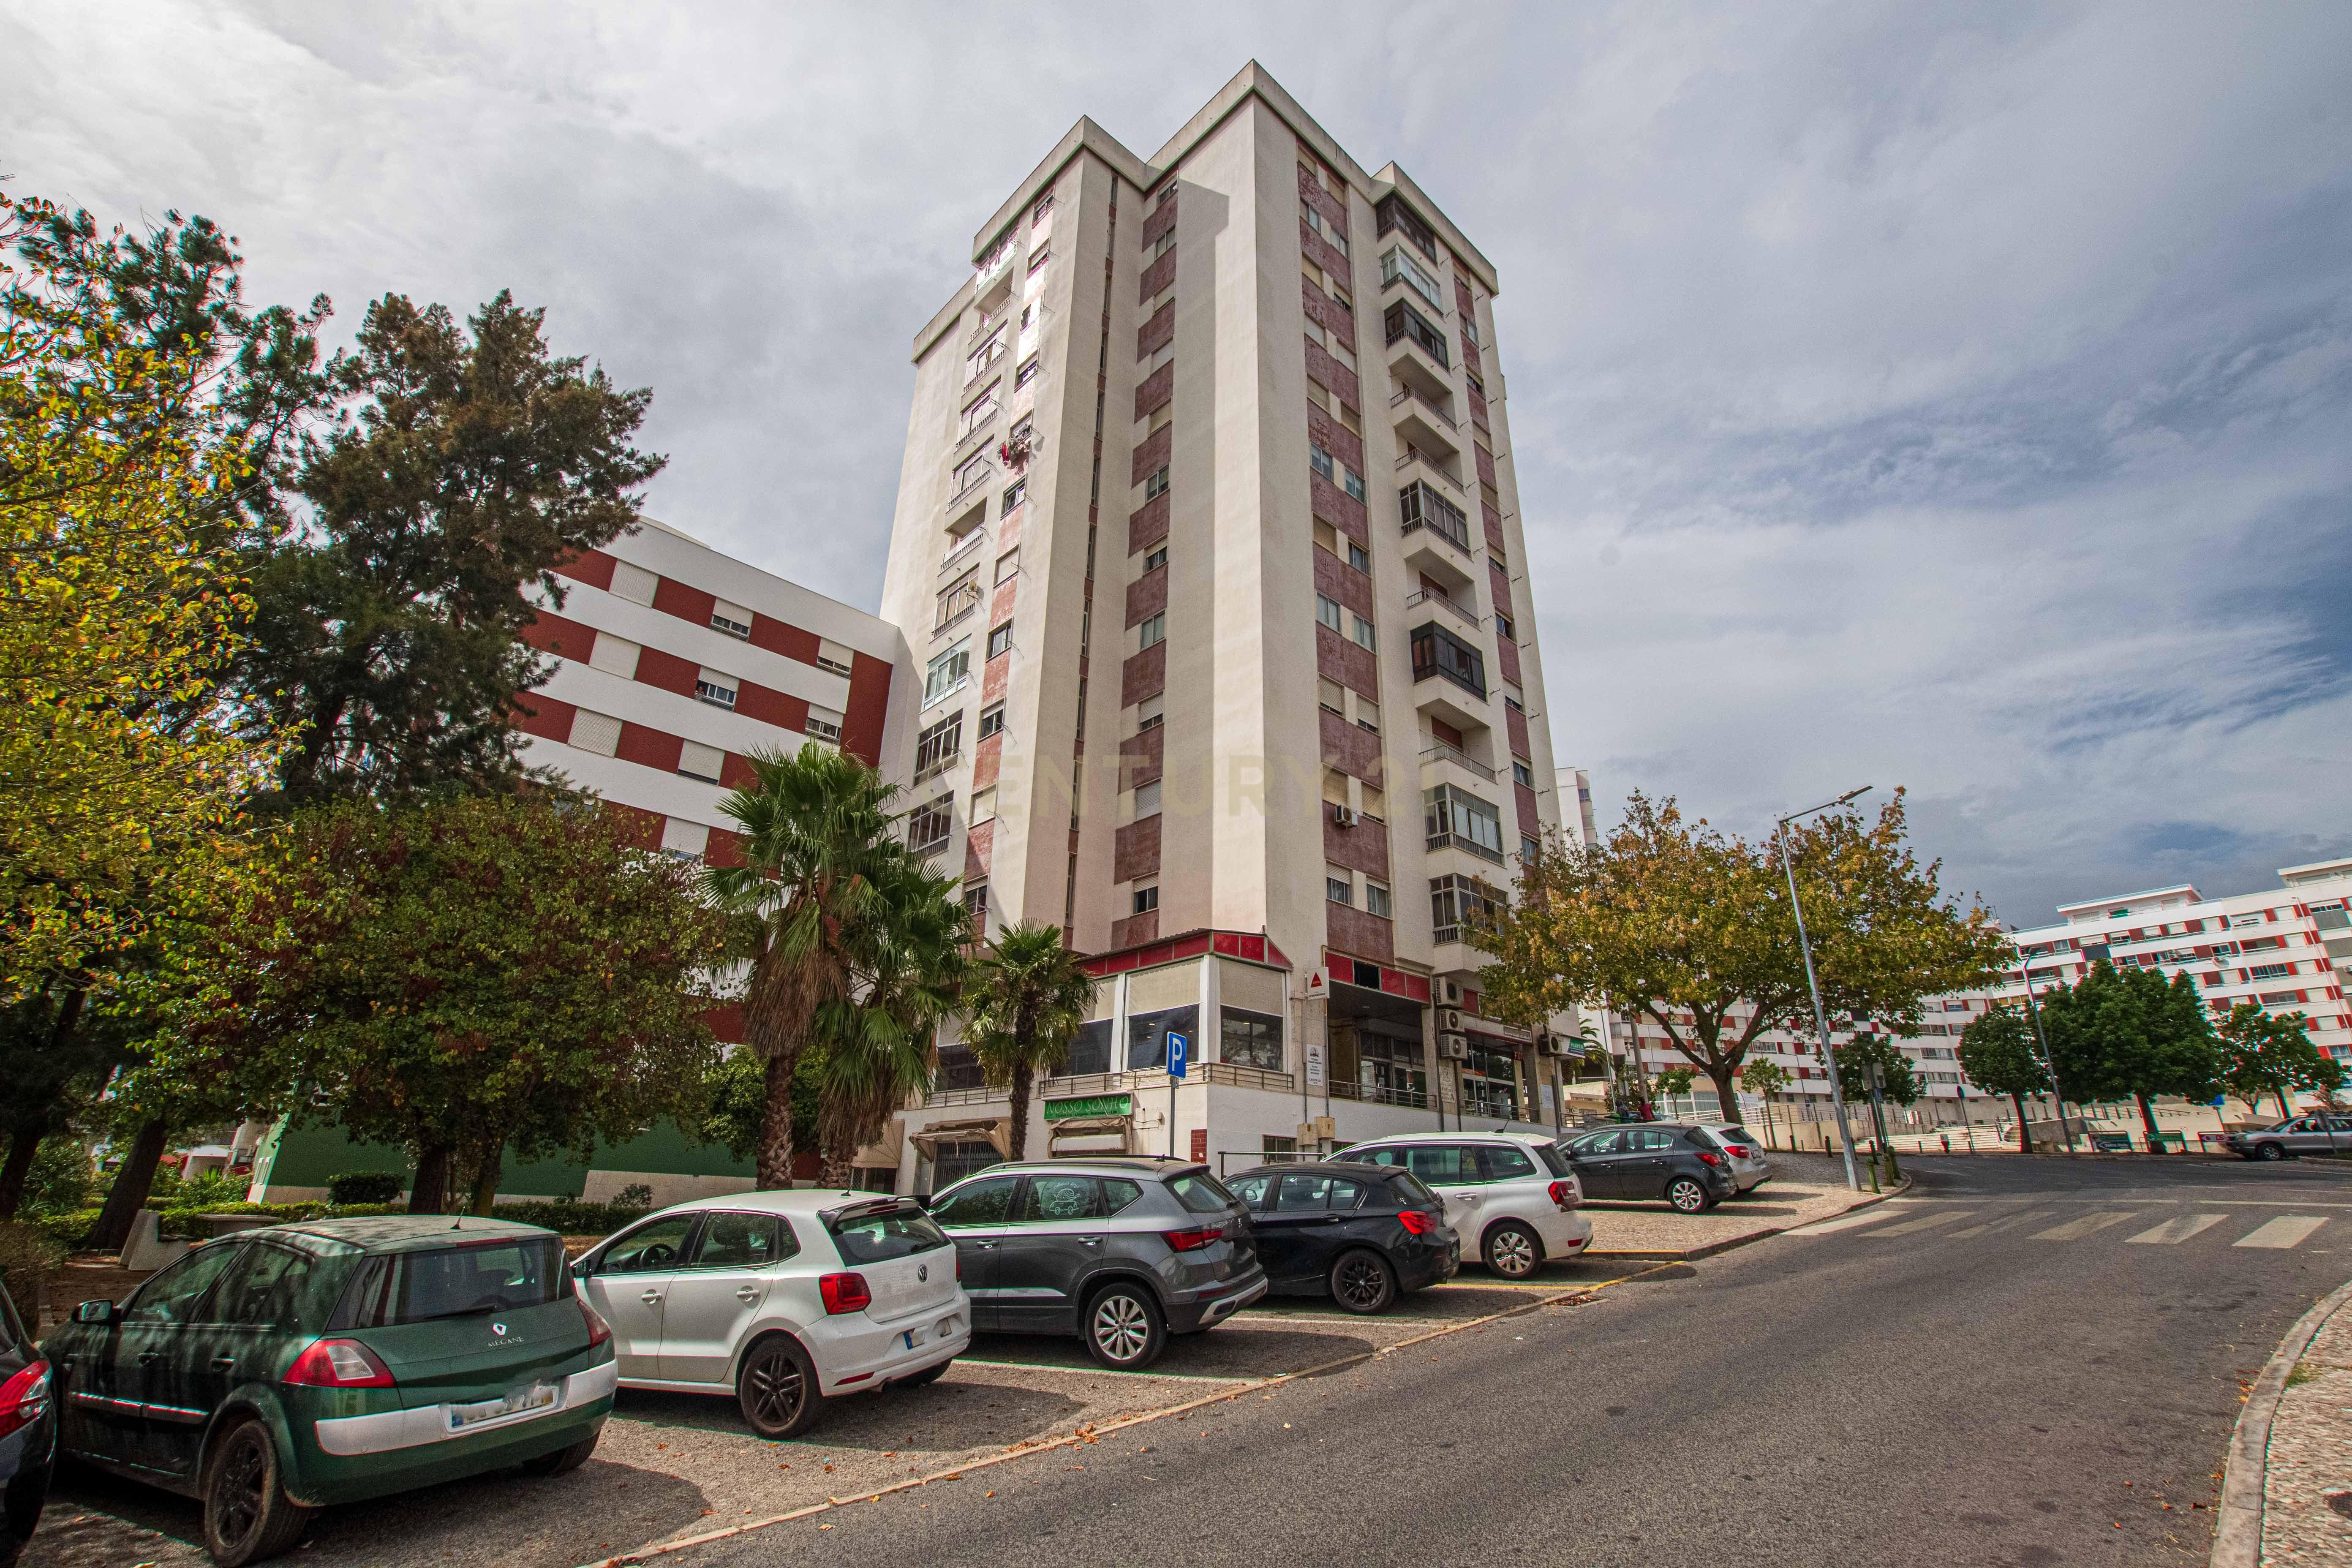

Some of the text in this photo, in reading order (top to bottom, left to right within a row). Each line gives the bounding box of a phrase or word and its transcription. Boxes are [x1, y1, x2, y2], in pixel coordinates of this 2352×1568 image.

[1172, 1037, 1182, 1071] P
[1047, 1096, 1129, 1114] NOSSO SONHO
[488, 1337, 524, 1347] MEGANE
